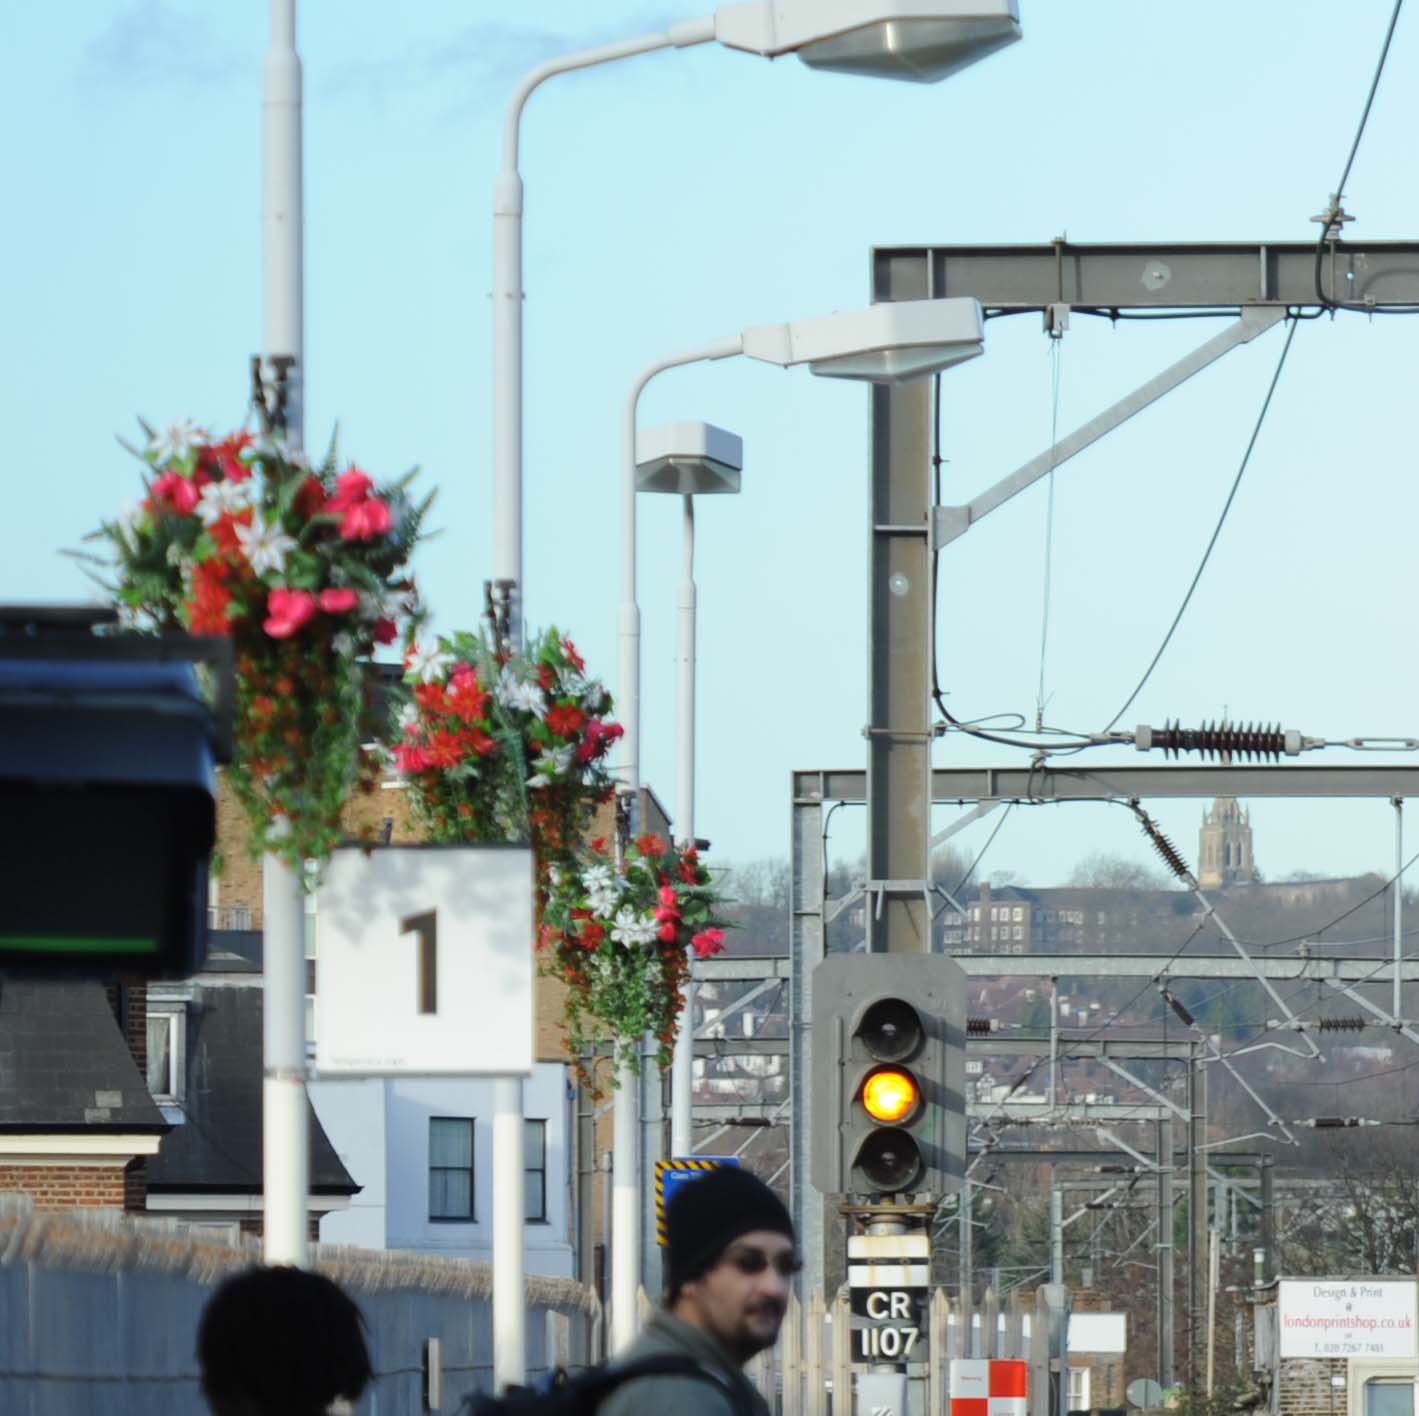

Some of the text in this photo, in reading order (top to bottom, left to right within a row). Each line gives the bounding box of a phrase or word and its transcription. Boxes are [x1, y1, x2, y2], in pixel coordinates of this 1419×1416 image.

[399, 906, 438, 1015] 1
[866, 1291, 911, 1320] CR
[1313, 1286, 1383, 1300] Design & Print
[1284, 1314, 1413, 1331] londonprintshop.co.uk
[862, 1327, 918, 1356] 1107
